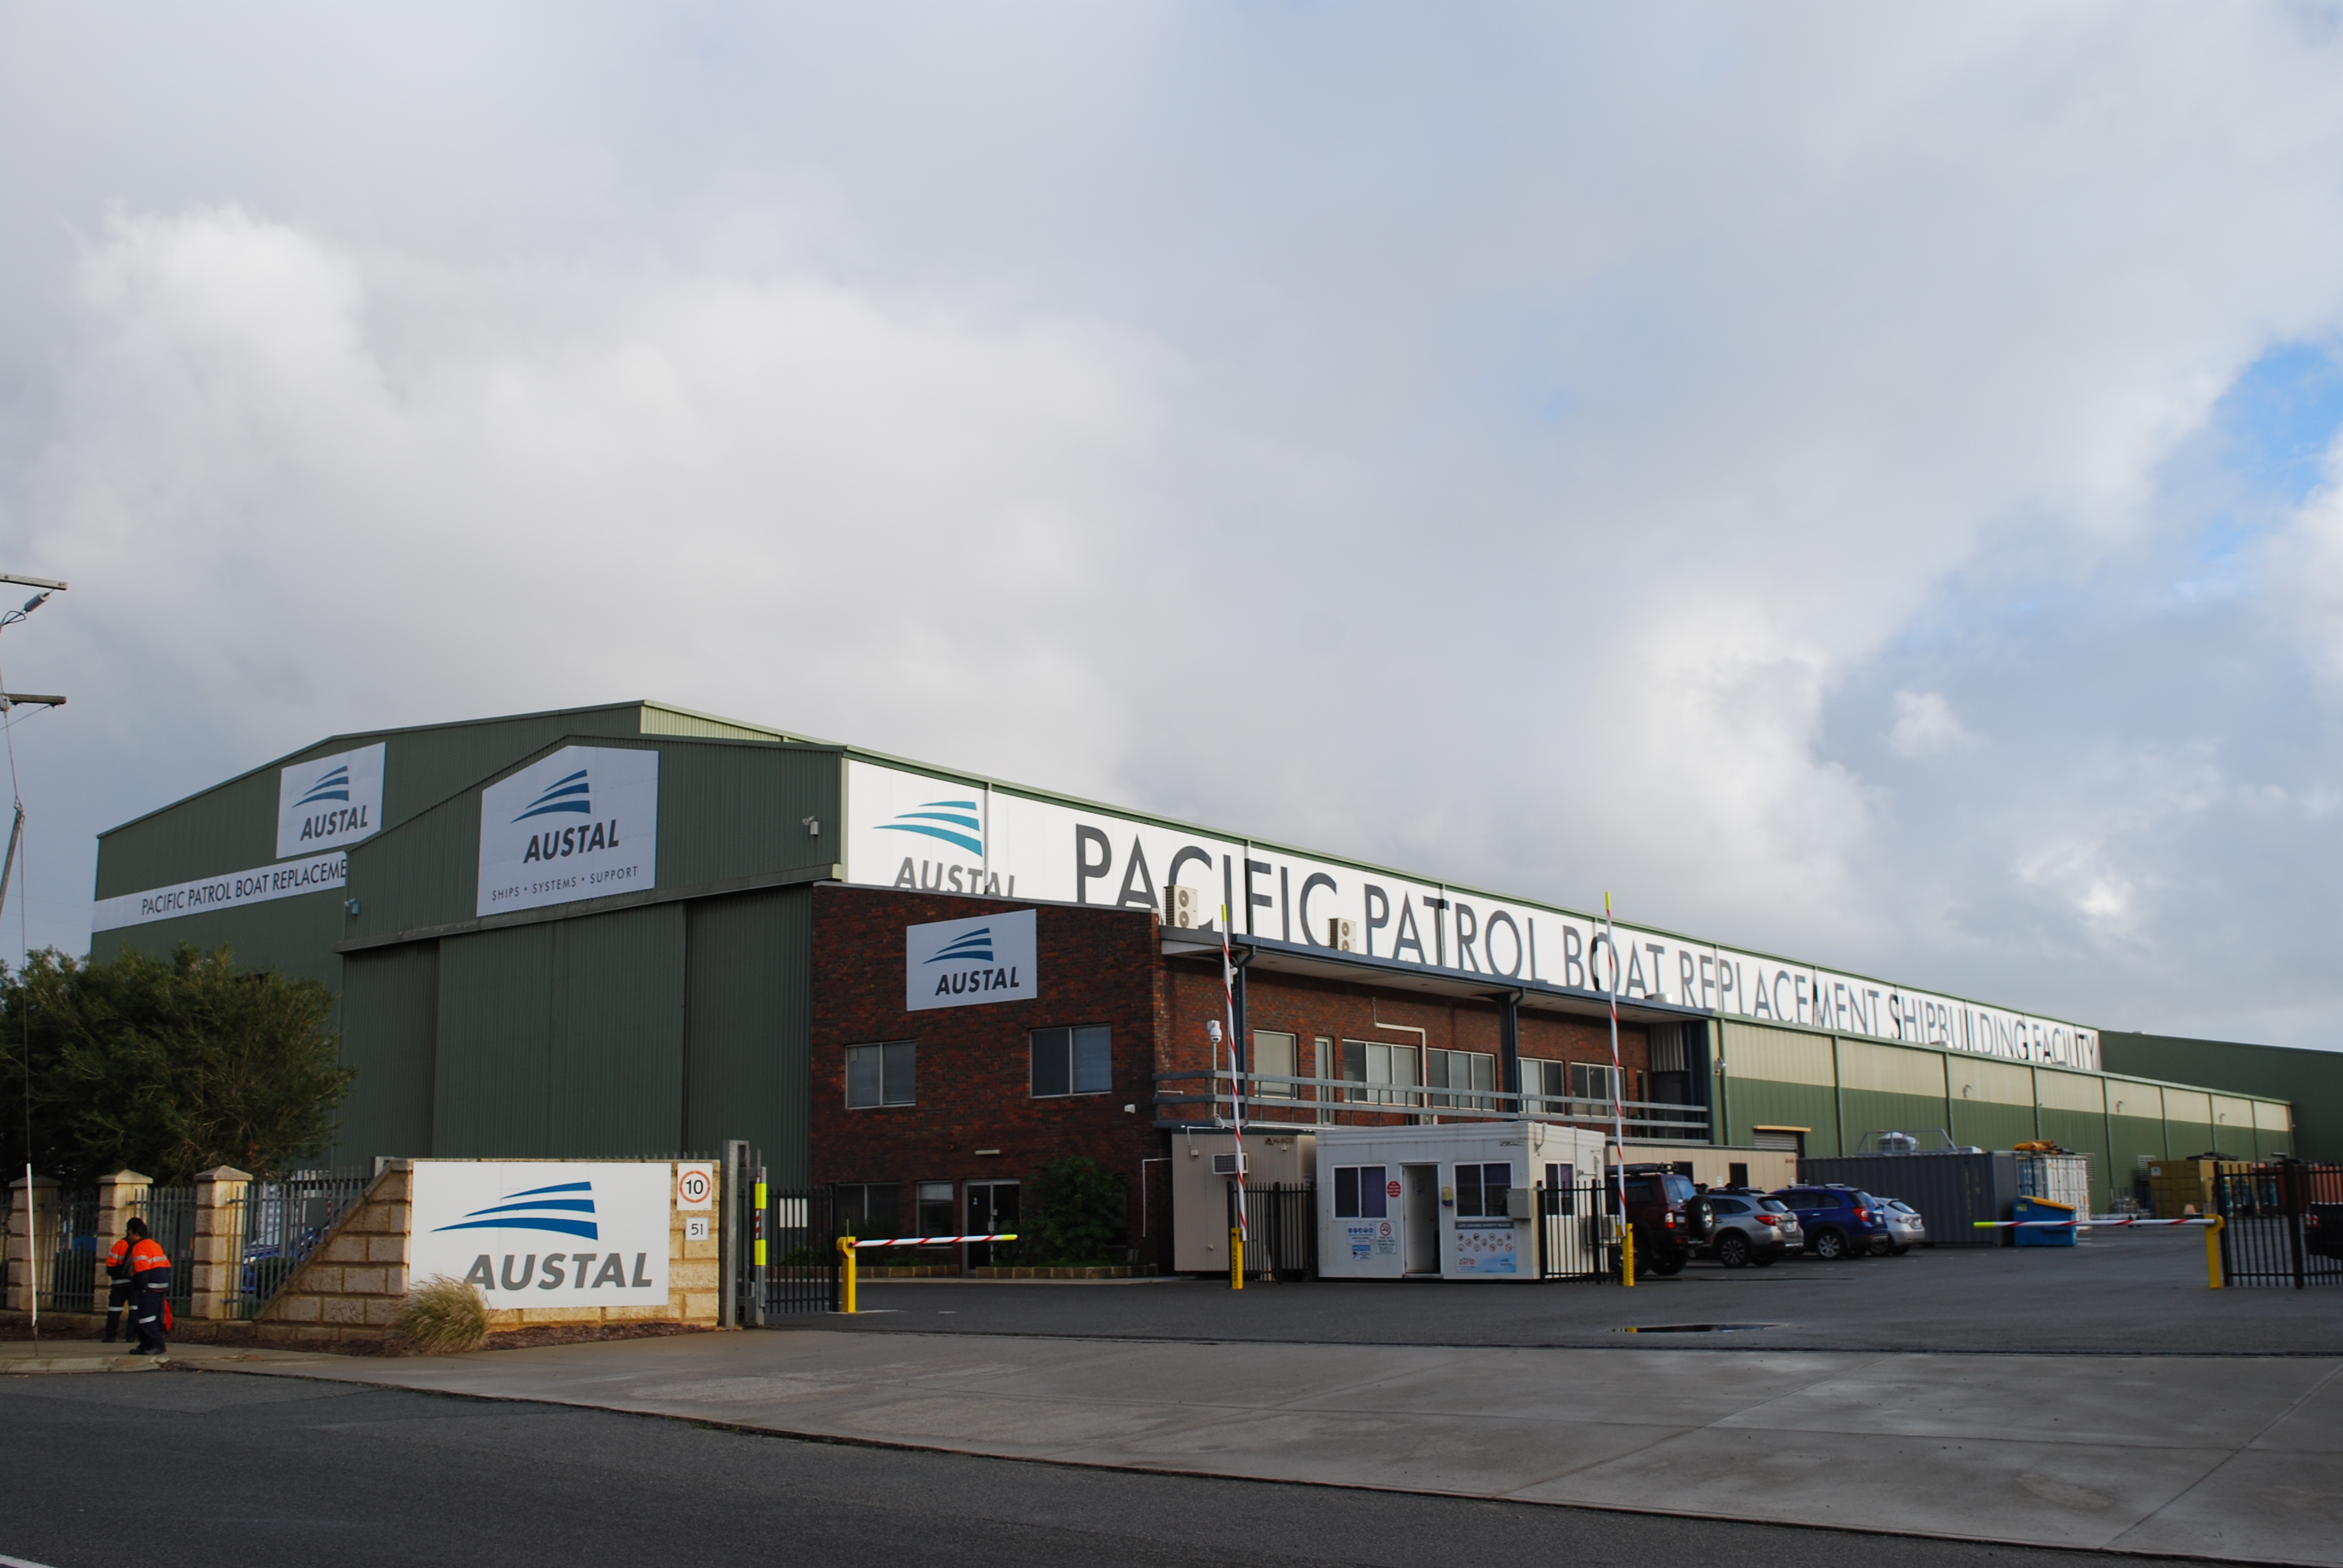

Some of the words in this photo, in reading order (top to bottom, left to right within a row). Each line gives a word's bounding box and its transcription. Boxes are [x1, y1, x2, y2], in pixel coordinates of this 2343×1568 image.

[300, 805, 368, 841] AUSTAL
[523, 819, 620, 864] AUSTAL
[142, 890, 185, 916] PACIFIC
[188, 883, 231, 907] PATROL
[235, 874, 270, 898] BOAT
[492, 886, 520, 901] SHIPS
[532, 876, 577, 894] SYSTEMS
[590, 866, 638, 884] SUPPORT
[894, 857, 1015, 897] AUSTAL
[1076, 824, 1337, 947] PACIFIC
[1365, 883, 1548, 983] PATROL
[1563, 924, 1664, 999] BOAT
[1679, 949, 1879, 1037] REPLACEMENT
[1889, 993, 2029, 1060] SHIPBUILDING
[2033, 1024, 2096, 1071] FACILITY
[935, 966, 1020, 996] AUSTAL
[686, 1179, 703, 1194] 10
[691, 1223, 703, 1235] 51
[463, 1252, 653, 1290] AUSTAL
